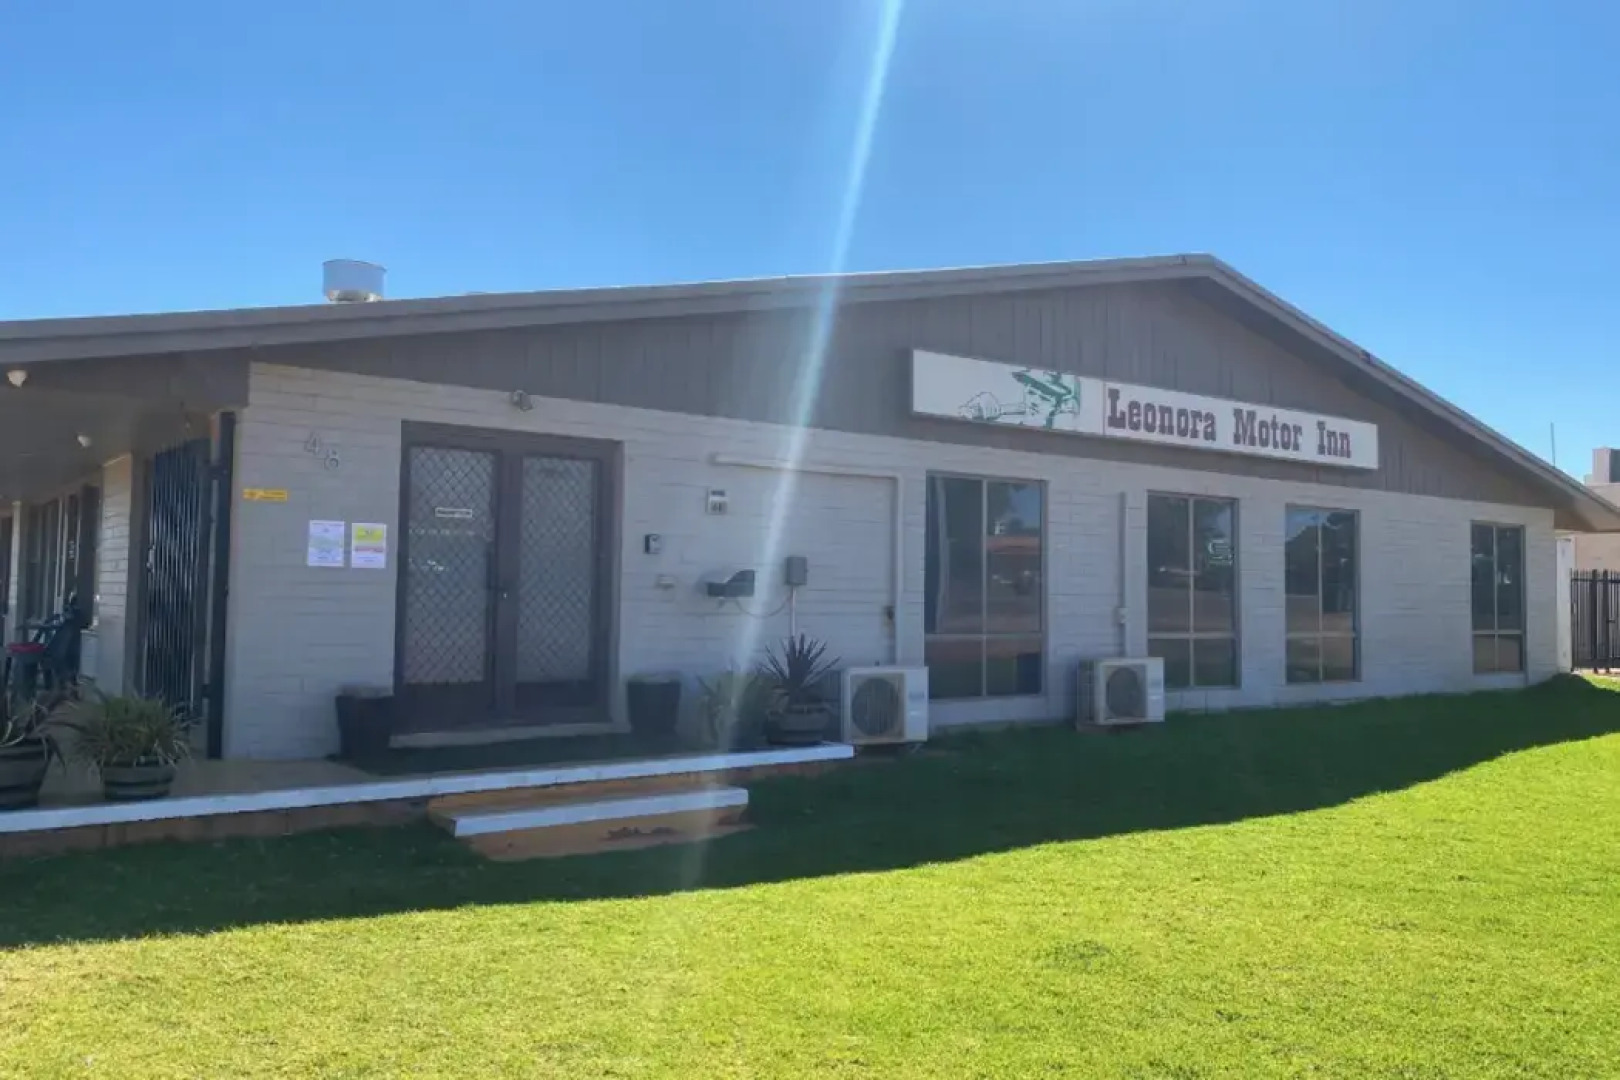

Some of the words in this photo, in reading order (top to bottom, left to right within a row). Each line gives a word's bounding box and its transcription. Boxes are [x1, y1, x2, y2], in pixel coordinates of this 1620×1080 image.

[1107, 388, 1216, 442] Leonora
[1233, 407, 1302, 451] Motor
[1316, 420, 1351, 458] Inn
